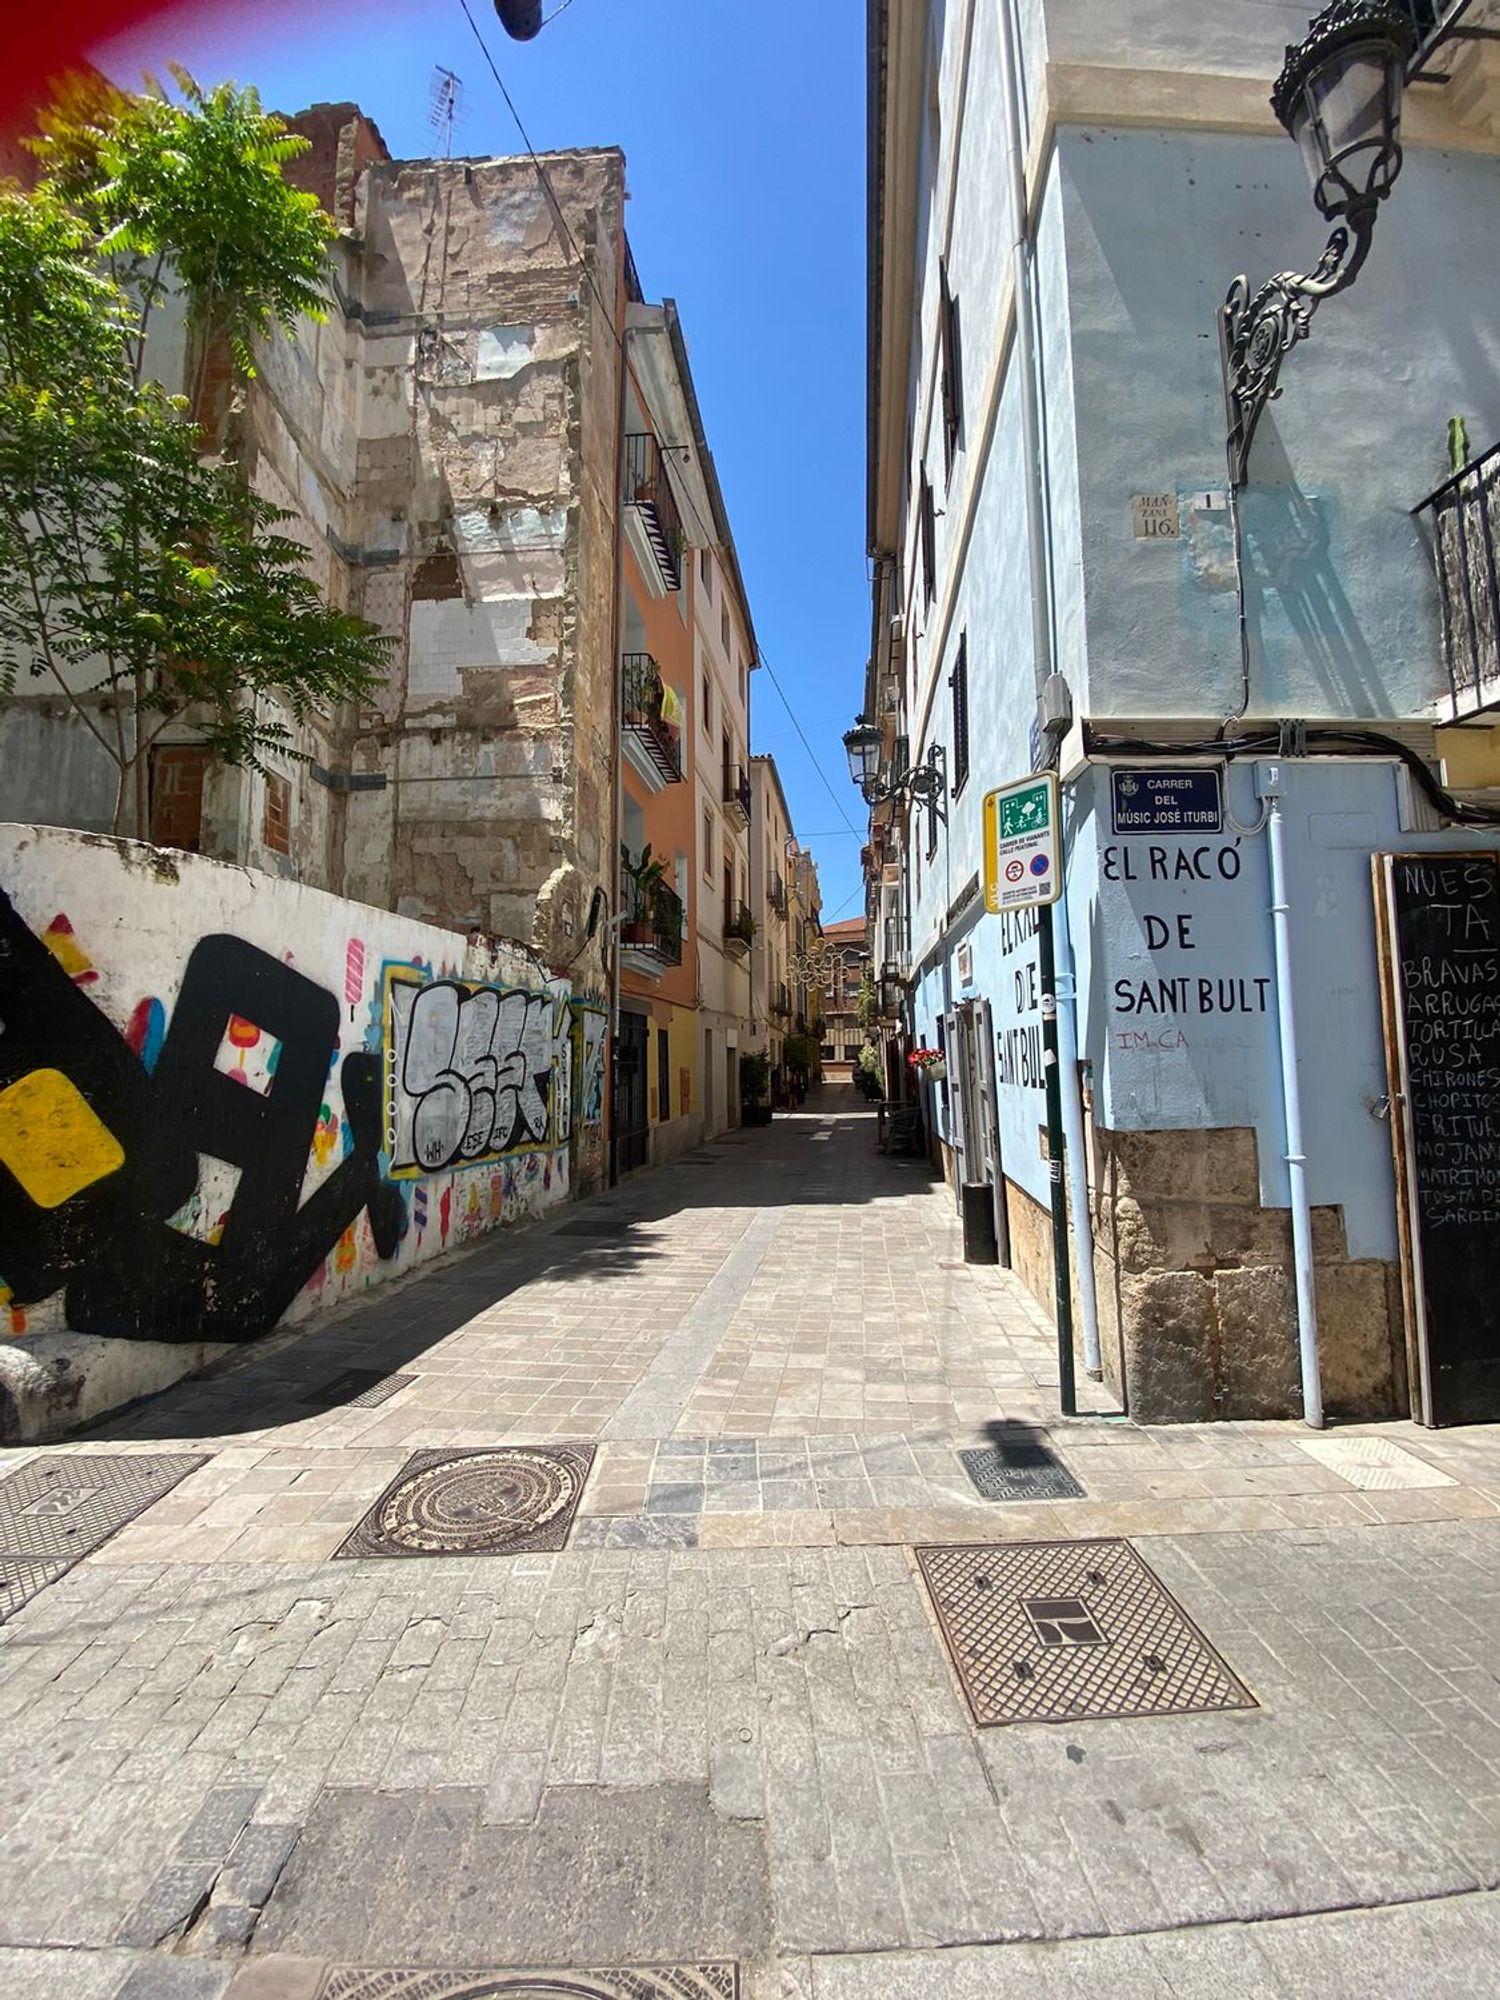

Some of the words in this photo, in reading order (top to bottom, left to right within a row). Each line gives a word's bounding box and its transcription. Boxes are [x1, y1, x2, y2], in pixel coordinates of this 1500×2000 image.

[1206, 494, 1211, 508] 1
[1147, 779, 1193, 790] CARRER
[1154, 795, 1178, 805] DEL
[1117, 809, 1151, 824] MÚSIC
[1153, 808, 1181, 824] JOSÉ
[1183, 810, 1218, 823] ITURBI
[1103, 846, 1137, 881] EL
[1149, 836, 1242, 881] RACÓ
[1405, 866, 1493, 898] NUES
[1143, 914, 1196, 950] DE
[1015, 962, 1038, 1014] DE
[1402, 956, 1498, 988] BRAVAS
[1114, 977, 1190, 1014] SANT
[1198, 978, 1271, 1014] BULT
[1407, 1018, 1500, 1044] TORTILLA
[1021, 1025, 1046, 1089] BUL
[1409, 1043, 1482, 1067] RUSA
